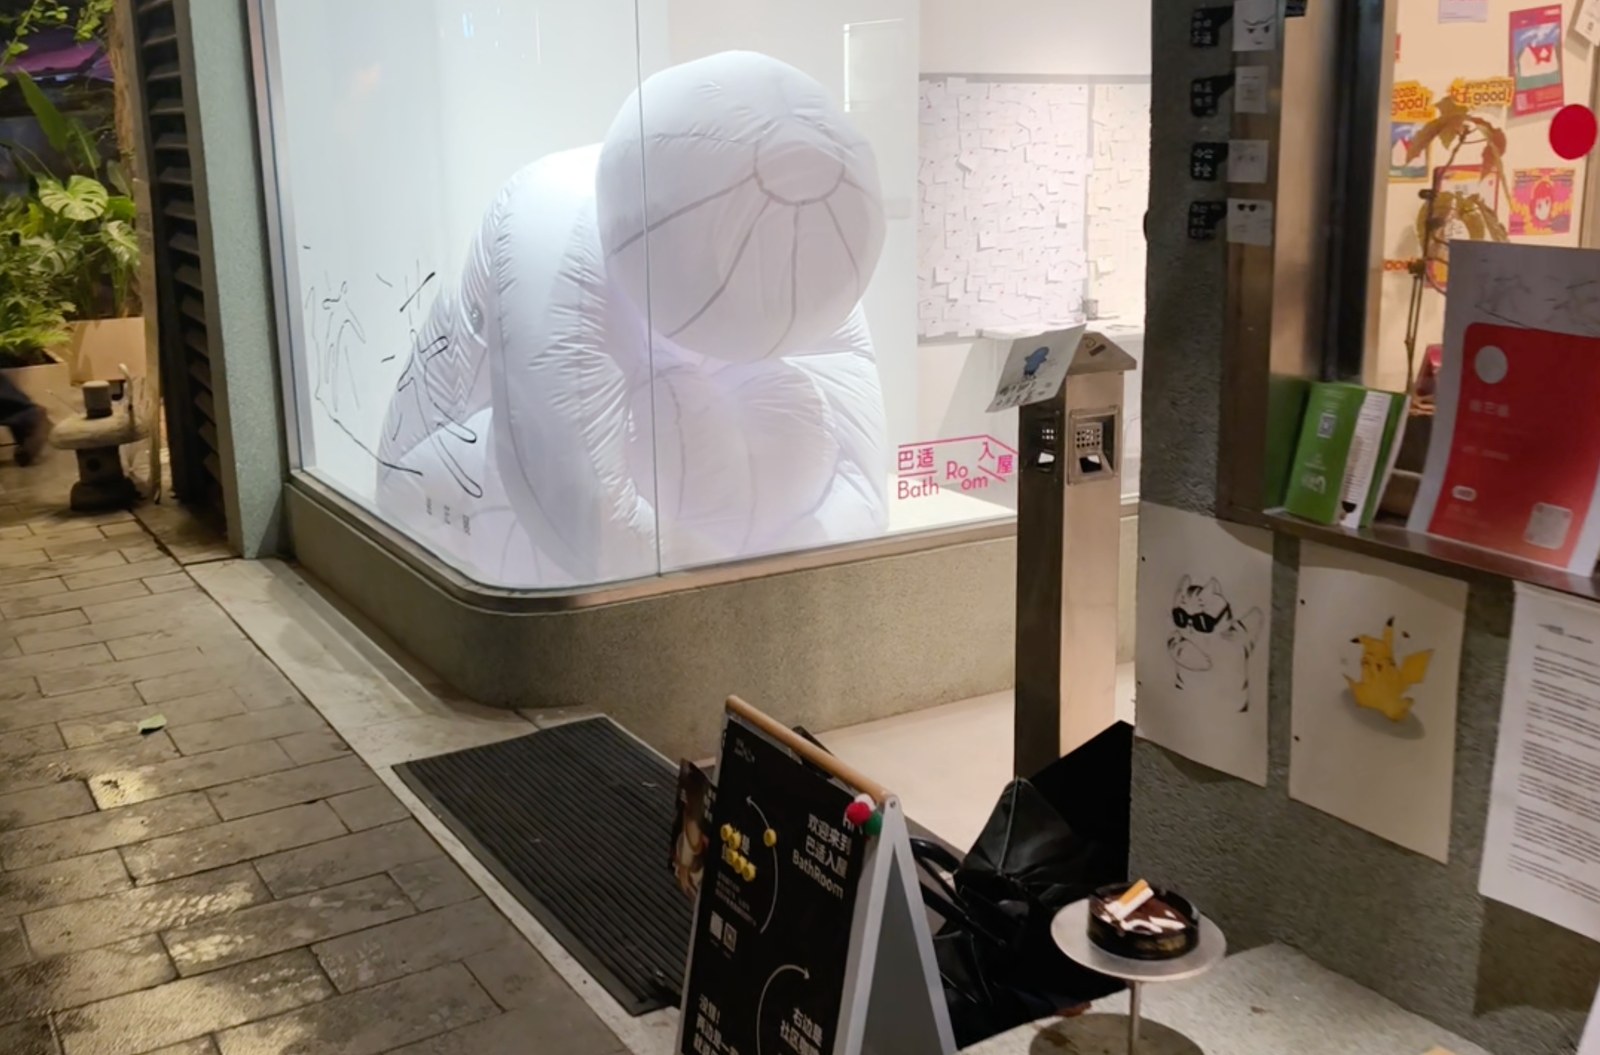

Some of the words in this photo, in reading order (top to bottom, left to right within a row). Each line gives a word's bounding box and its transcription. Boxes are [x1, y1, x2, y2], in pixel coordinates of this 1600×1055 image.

[898, 447, 934, 470] 巴适
[898, 476, 939, 499] Bath
[808, 813, 853, 855] 欢迎来到
[792, 848, 844, 899] BathRoom
[805, 835, 848, 880] 巴适入屋
